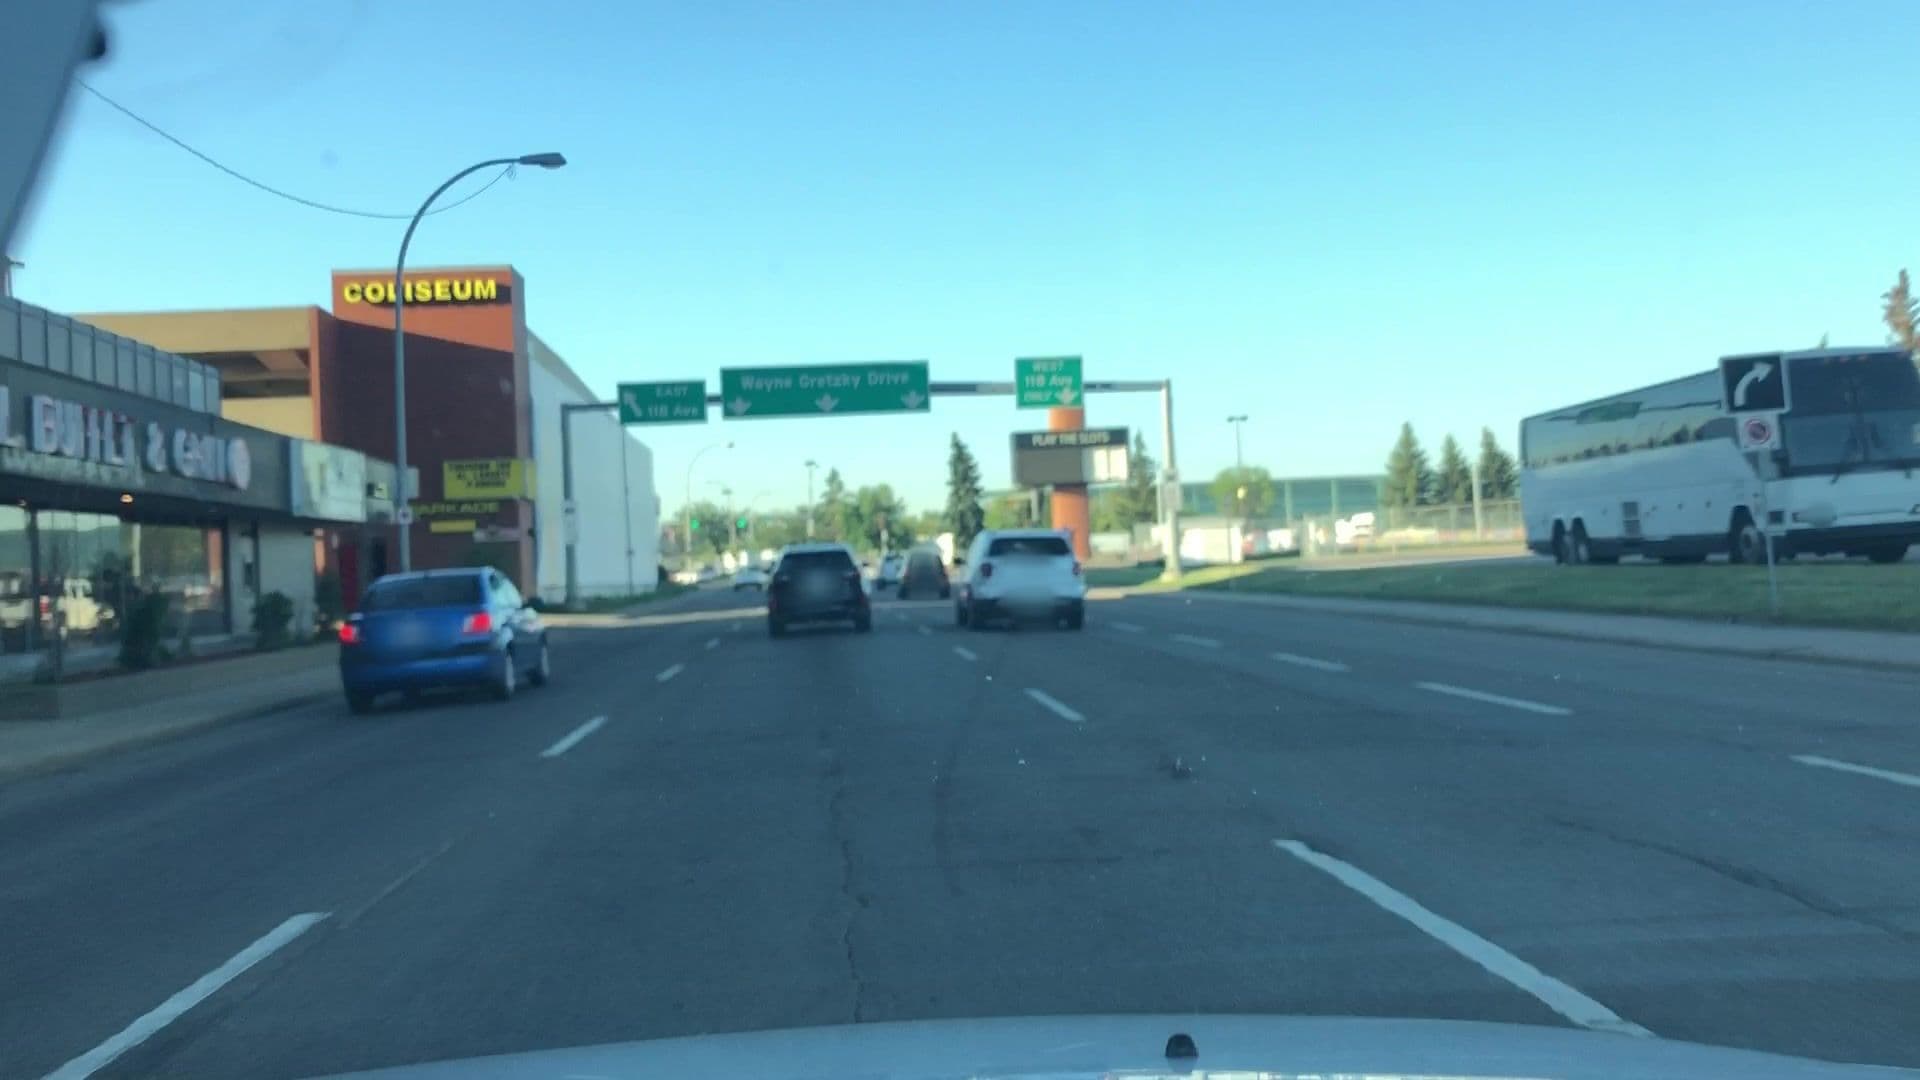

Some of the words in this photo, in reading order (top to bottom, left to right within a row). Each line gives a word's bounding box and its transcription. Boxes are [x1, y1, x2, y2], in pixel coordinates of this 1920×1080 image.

[343, 278, 497, 304] COLISEUM
[740, 374, 793, 391] Wayne
[798, 371, 861, 389] Gretzky
[867, 369, 910, 385] Drive
[1024, 375, 1045, 387] 118
[1048, 374, 1073, 387] Ave
[655, 383, 688, 397] EAST
[647, 403, 668, 416] 118
[672, 402, 699, 416] Ave
[146, 420, 166, 472] &
[1032, 434, 1057, 447] PLAY
